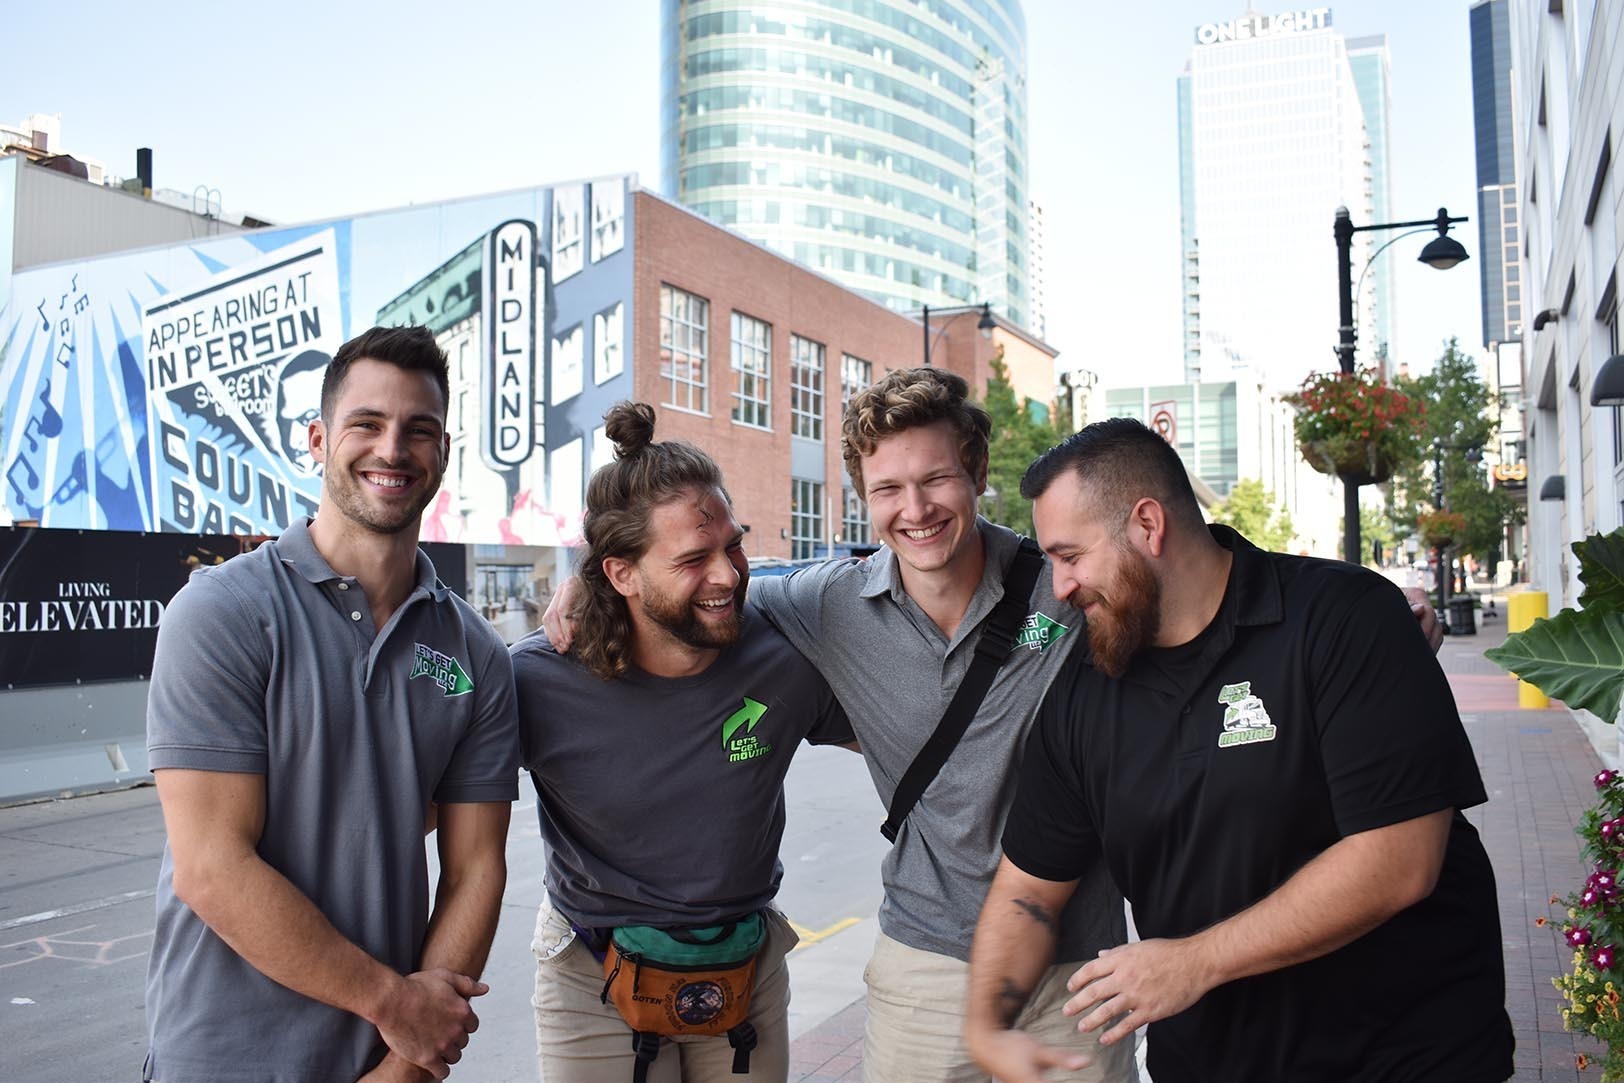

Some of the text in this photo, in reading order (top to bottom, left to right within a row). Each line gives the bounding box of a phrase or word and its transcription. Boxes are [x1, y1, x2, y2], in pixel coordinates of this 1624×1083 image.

[1195, 7, 1331, 45] ONE LIGHT
[149, 271, 312, 353] APPEARING AT
[149, 306, 322, 391] IN PERSON
[501, 236, 523, 451] MIDLAND
[58, 582, 111, 598] LIVING
[0, 599, 165, 633] ELEVATED
[435, 653, 451, 670] GET
